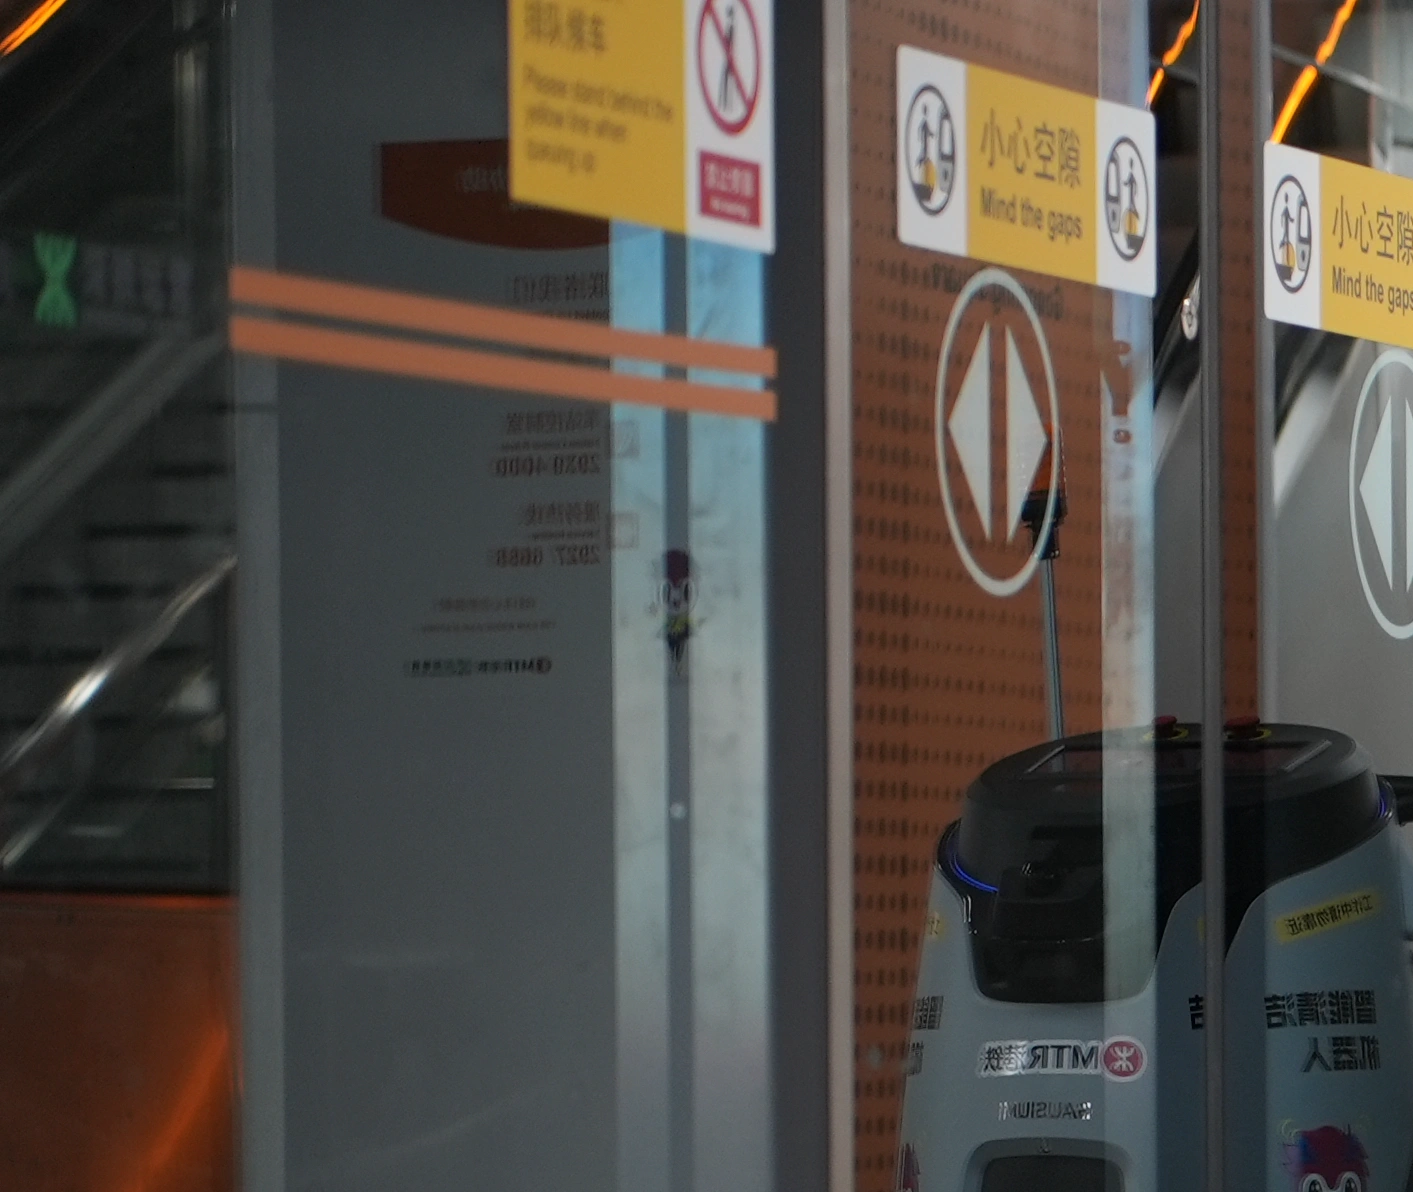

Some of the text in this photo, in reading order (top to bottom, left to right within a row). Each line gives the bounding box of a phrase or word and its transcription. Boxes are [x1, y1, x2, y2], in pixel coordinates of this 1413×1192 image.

[980, 106, 1082, 190] 小心空隙
[980, 185, 1084, 244] Mind the gaps
[1332, 265, 1362, 299] Mind
[1365, 273, 1385, 304] the
